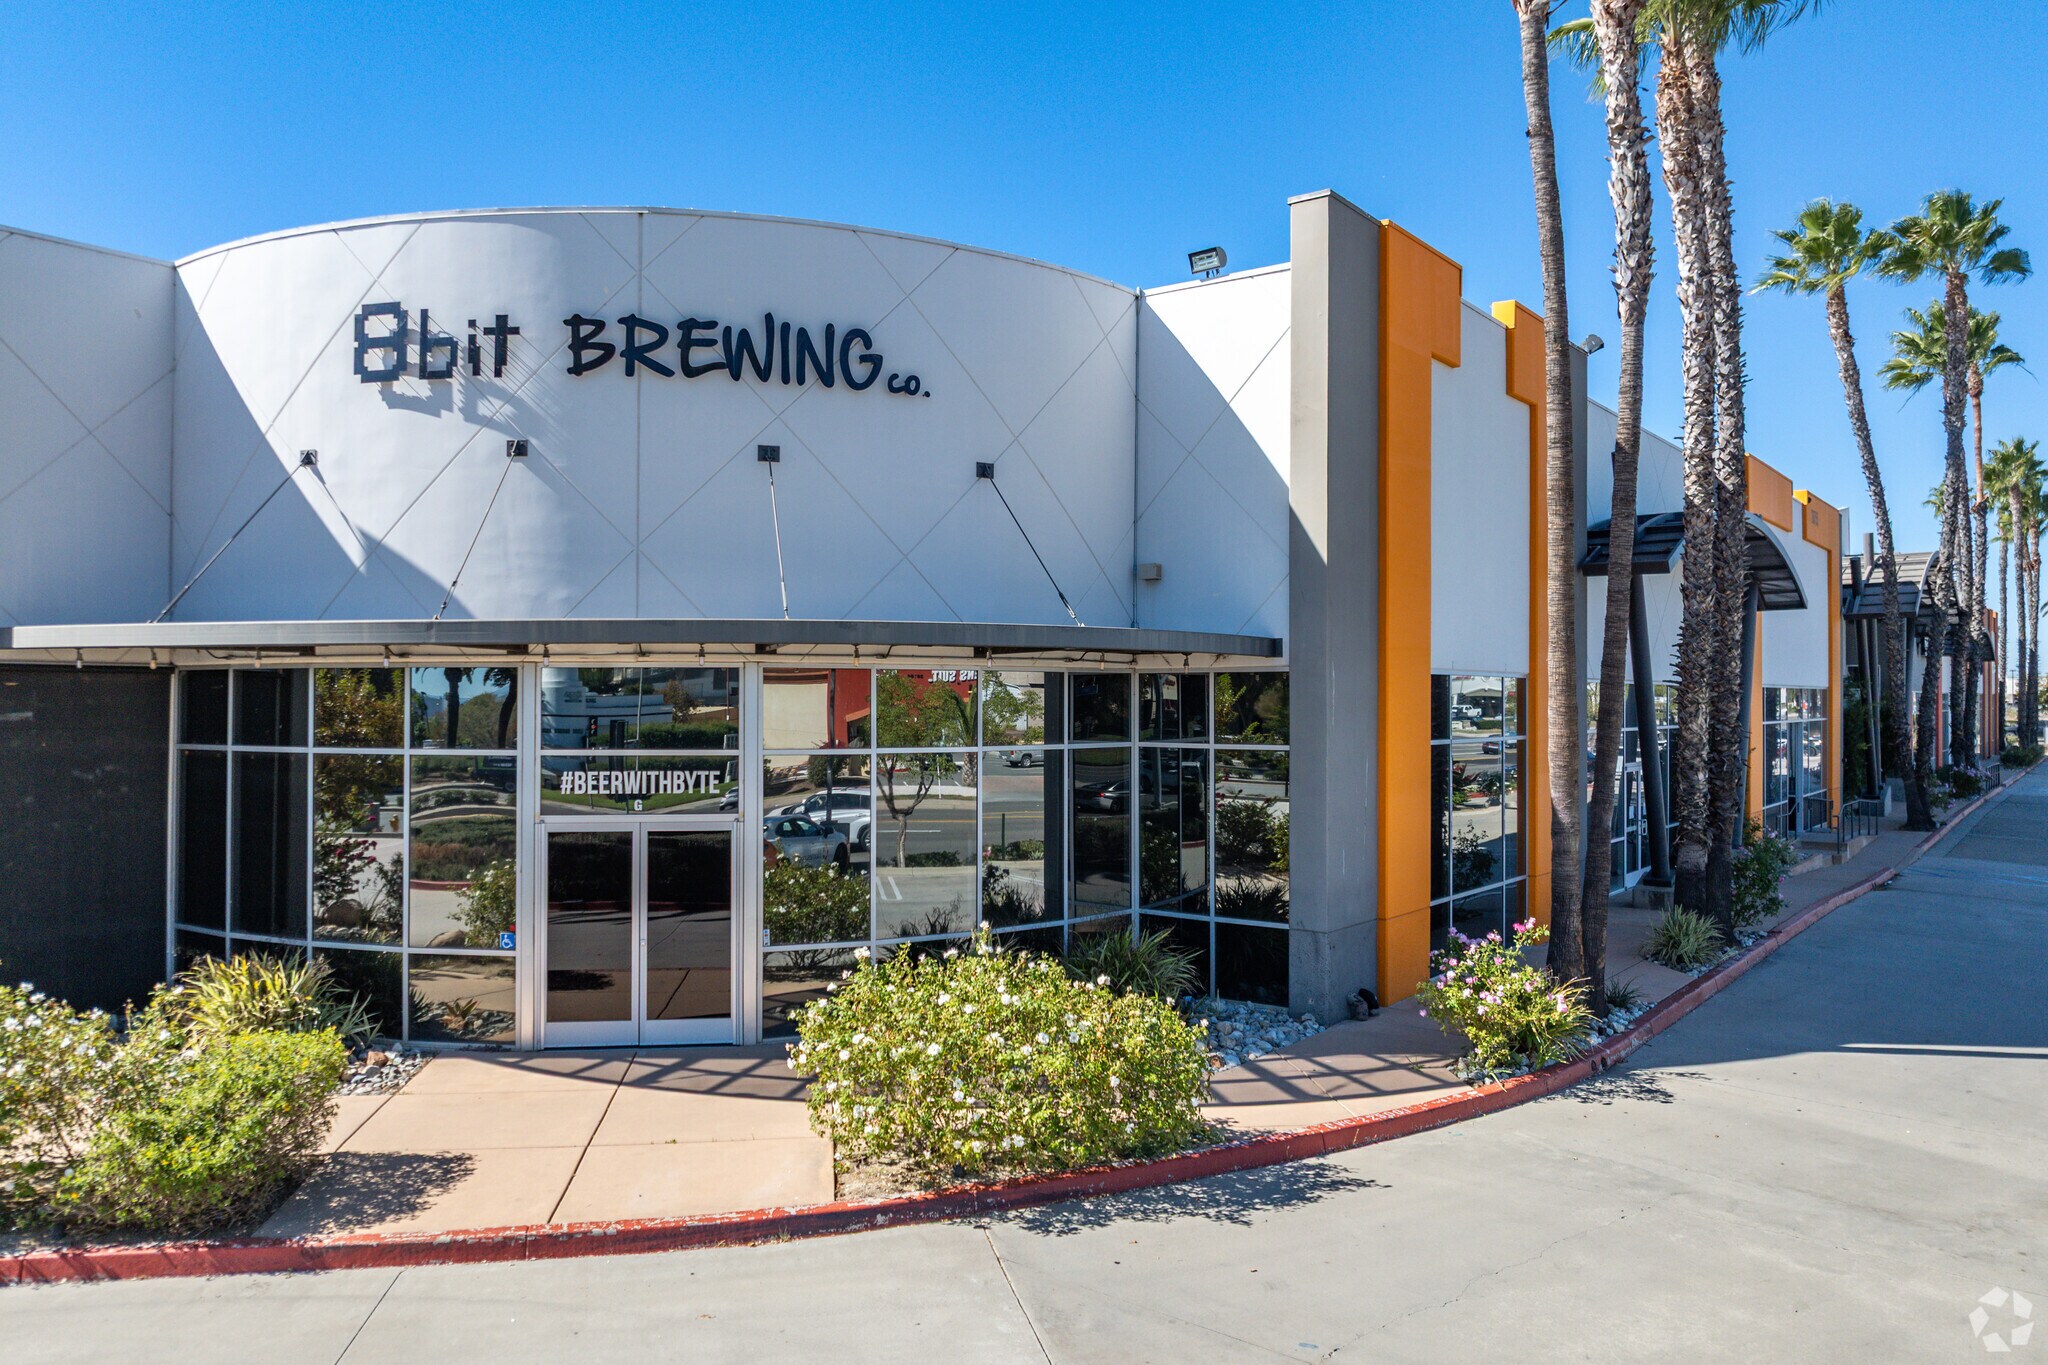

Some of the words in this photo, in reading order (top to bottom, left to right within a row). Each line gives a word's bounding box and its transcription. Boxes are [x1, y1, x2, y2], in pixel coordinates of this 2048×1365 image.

[353, 301, 520, 384] 8bit
[563, 312, 883, 391] BREWING
[560, 770, 721, 795] #BEERWITHBYTE
[634, 799, 643, 811] G
